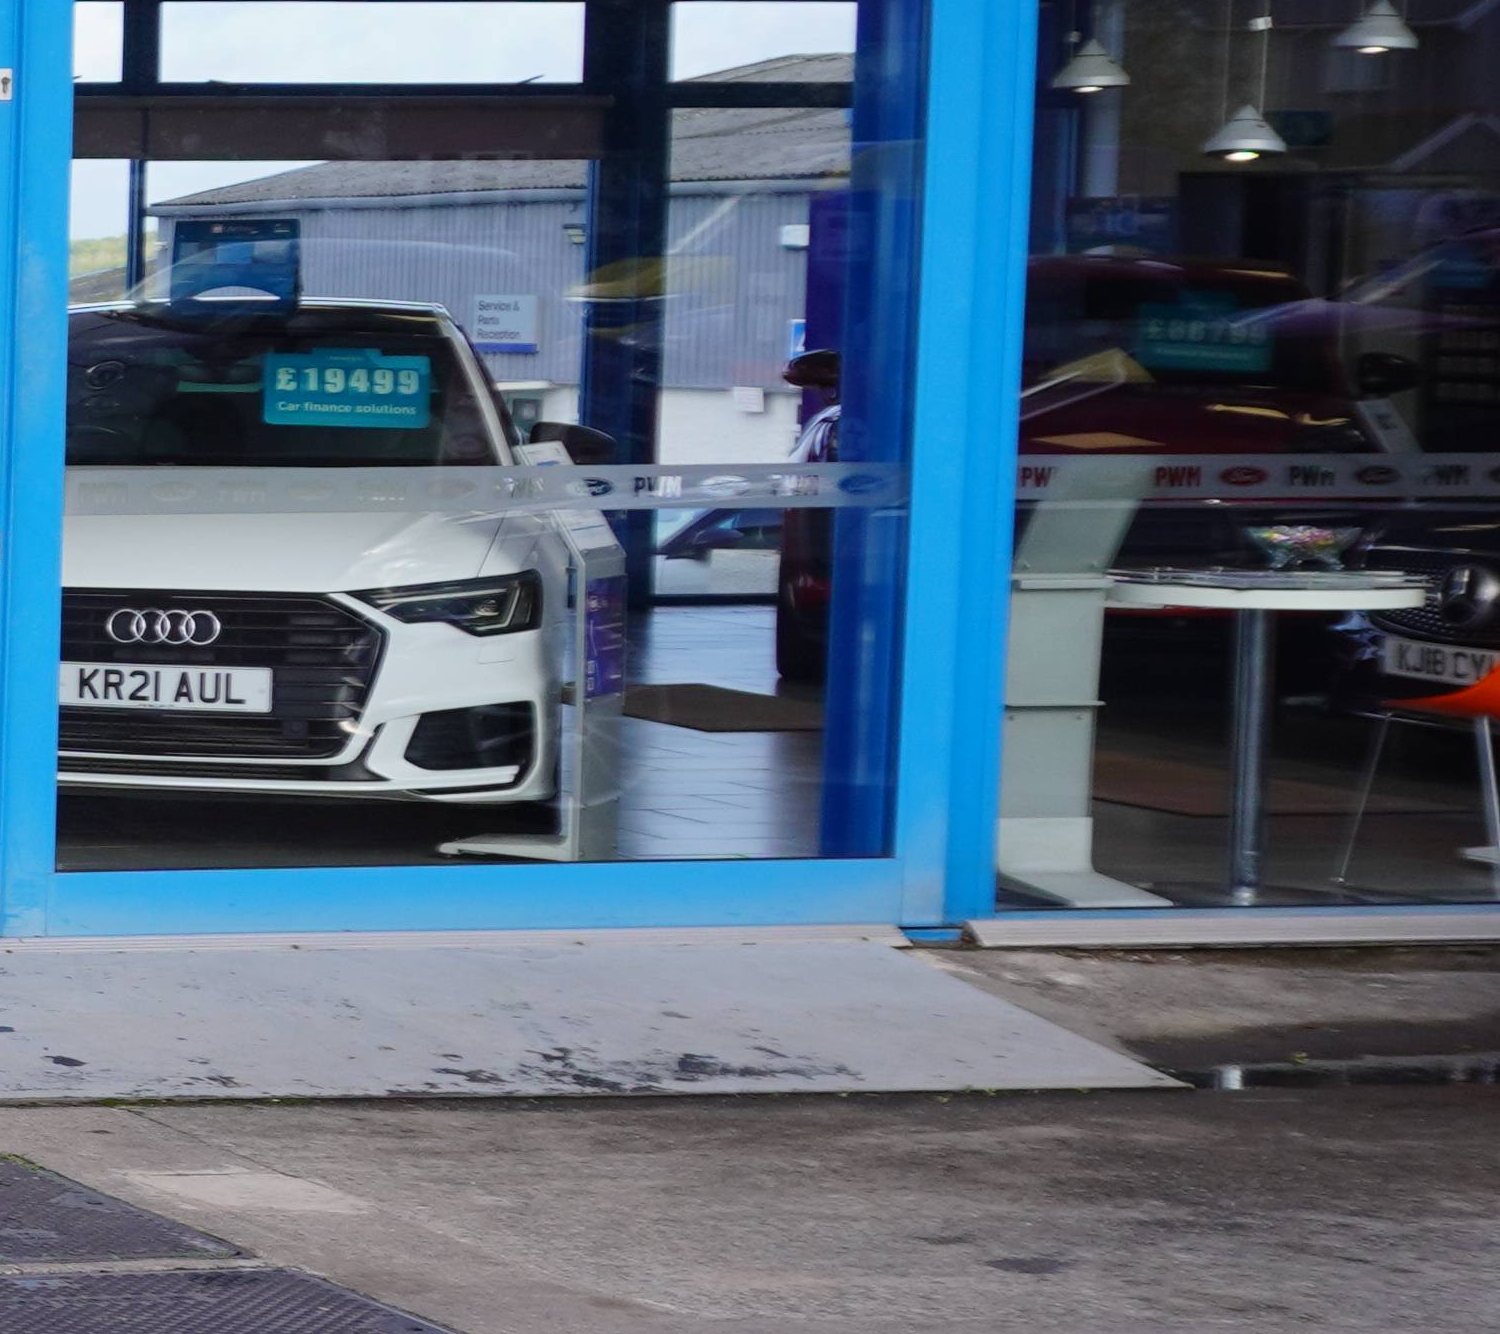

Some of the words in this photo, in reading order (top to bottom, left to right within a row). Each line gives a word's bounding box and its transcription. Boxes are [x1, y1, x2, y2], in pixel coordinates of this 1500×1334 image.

[275, 366, 420, 395] £19499
[277, 401, 299, 412] Car
[303, 401, 352, 413] finance
[355, 403, 417, 416] solutions
[1155, 466, 1200, 487] PWM
[79, 668, 161, 701] KR21
[174, 671, 246, 704] AUL
